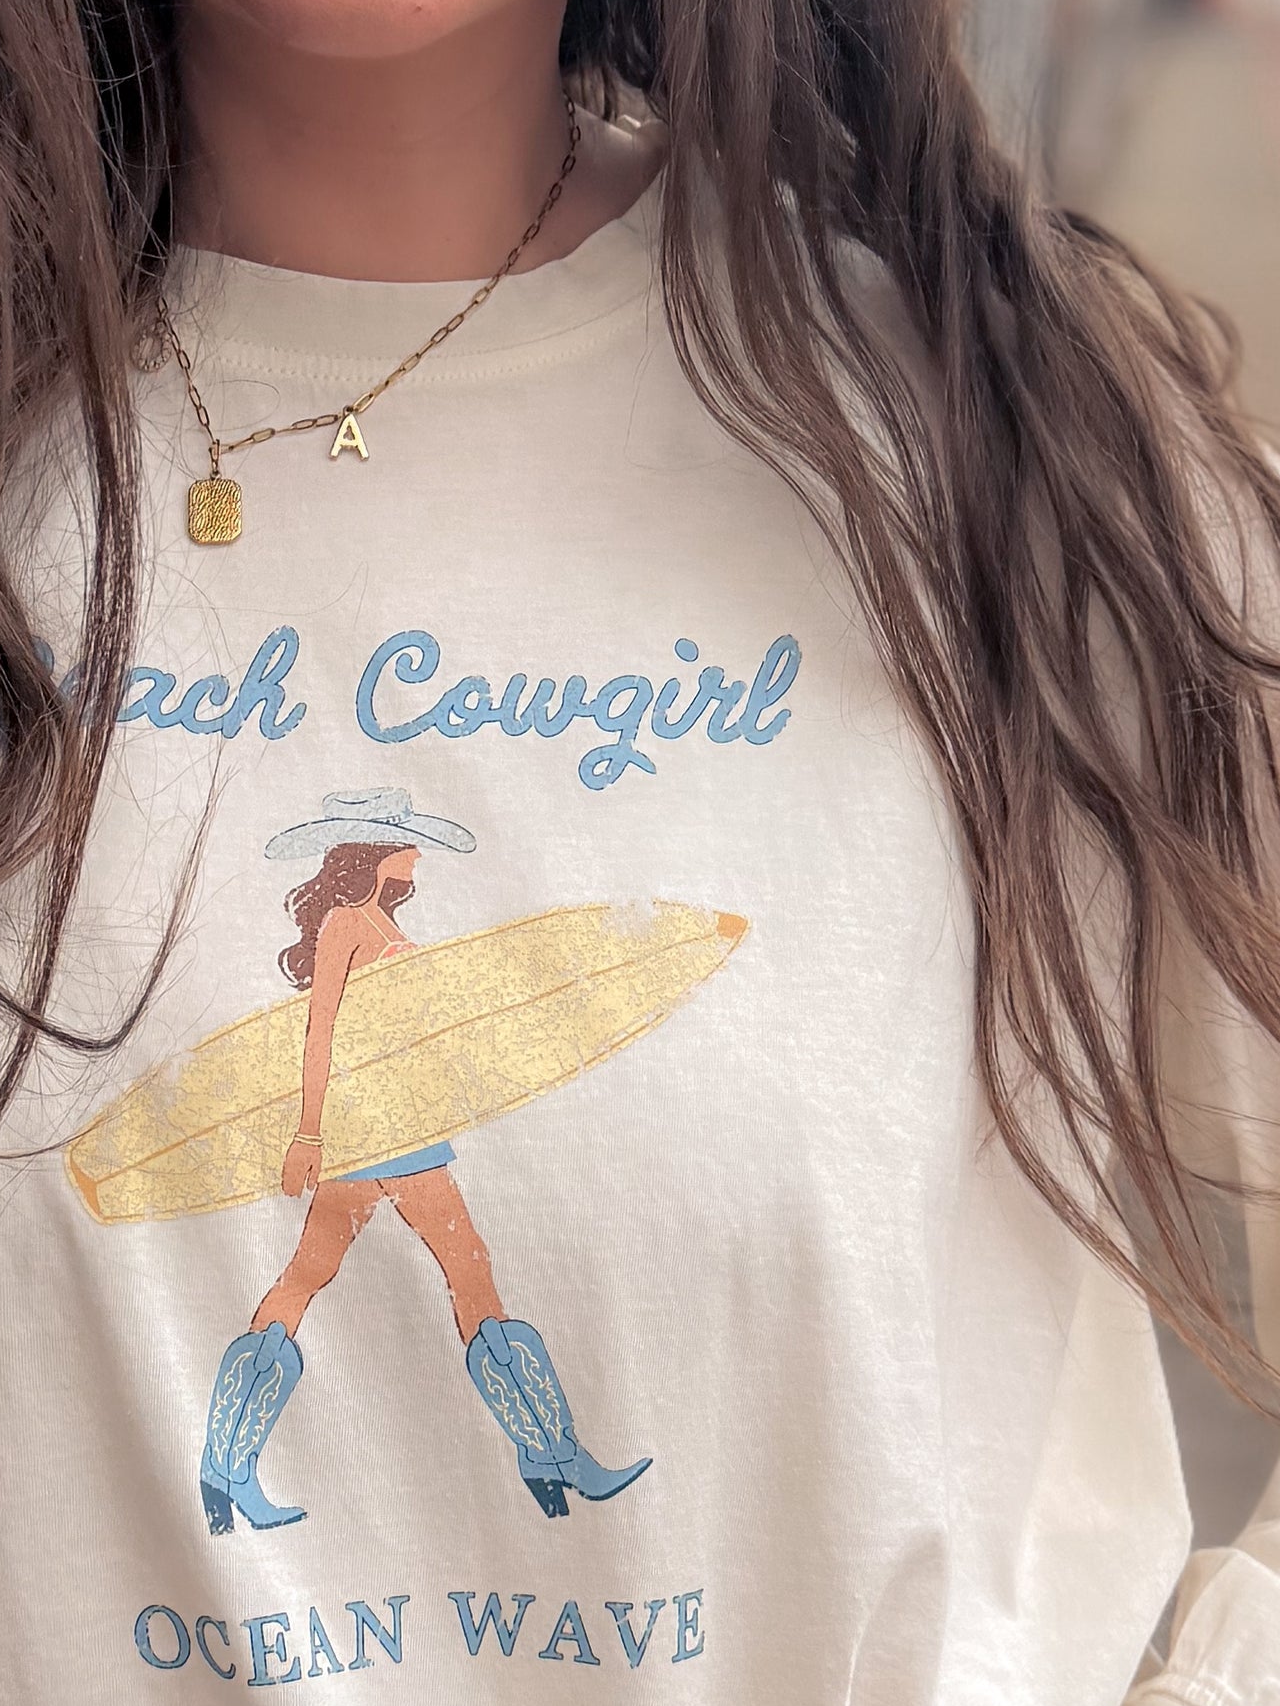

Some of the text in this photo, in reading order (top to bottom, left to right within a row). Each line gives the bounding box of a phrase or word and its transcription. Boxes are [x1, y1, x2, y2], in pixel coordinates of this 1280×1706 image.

[328, 411, 370, 461] A
[355, 629, 803, 791] Cowgirl
[133, 1589, 705, 1686] OCEAN WAVE
